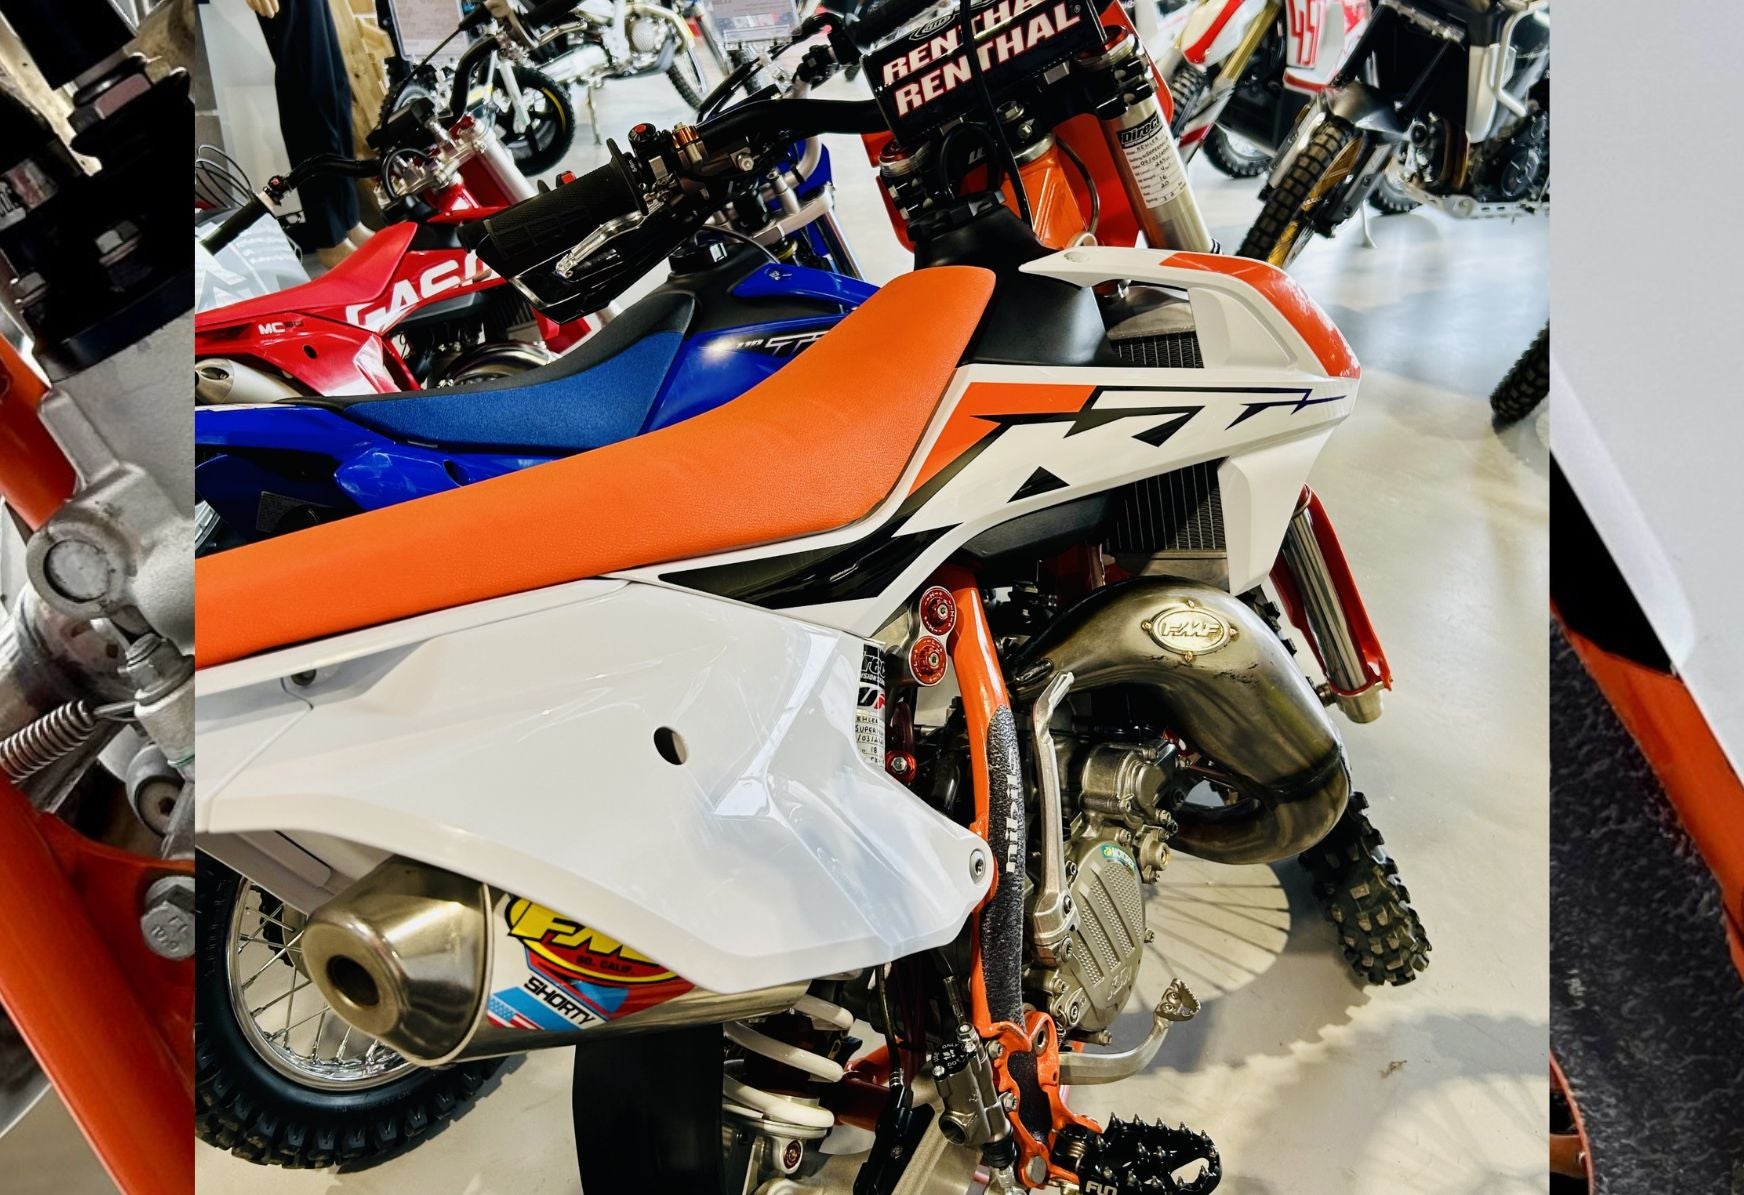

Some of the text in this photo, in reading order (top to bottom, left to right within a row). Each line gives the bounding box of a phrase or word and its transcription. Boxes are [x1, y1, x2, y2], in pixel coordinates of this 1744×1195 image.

[894, 3, 1081, 117] RENTHAL
[1161, 620, 1221, 638] FMF
[509, 902, 660, 967] FM
[523, 974, 595, 1025] SHORTY
